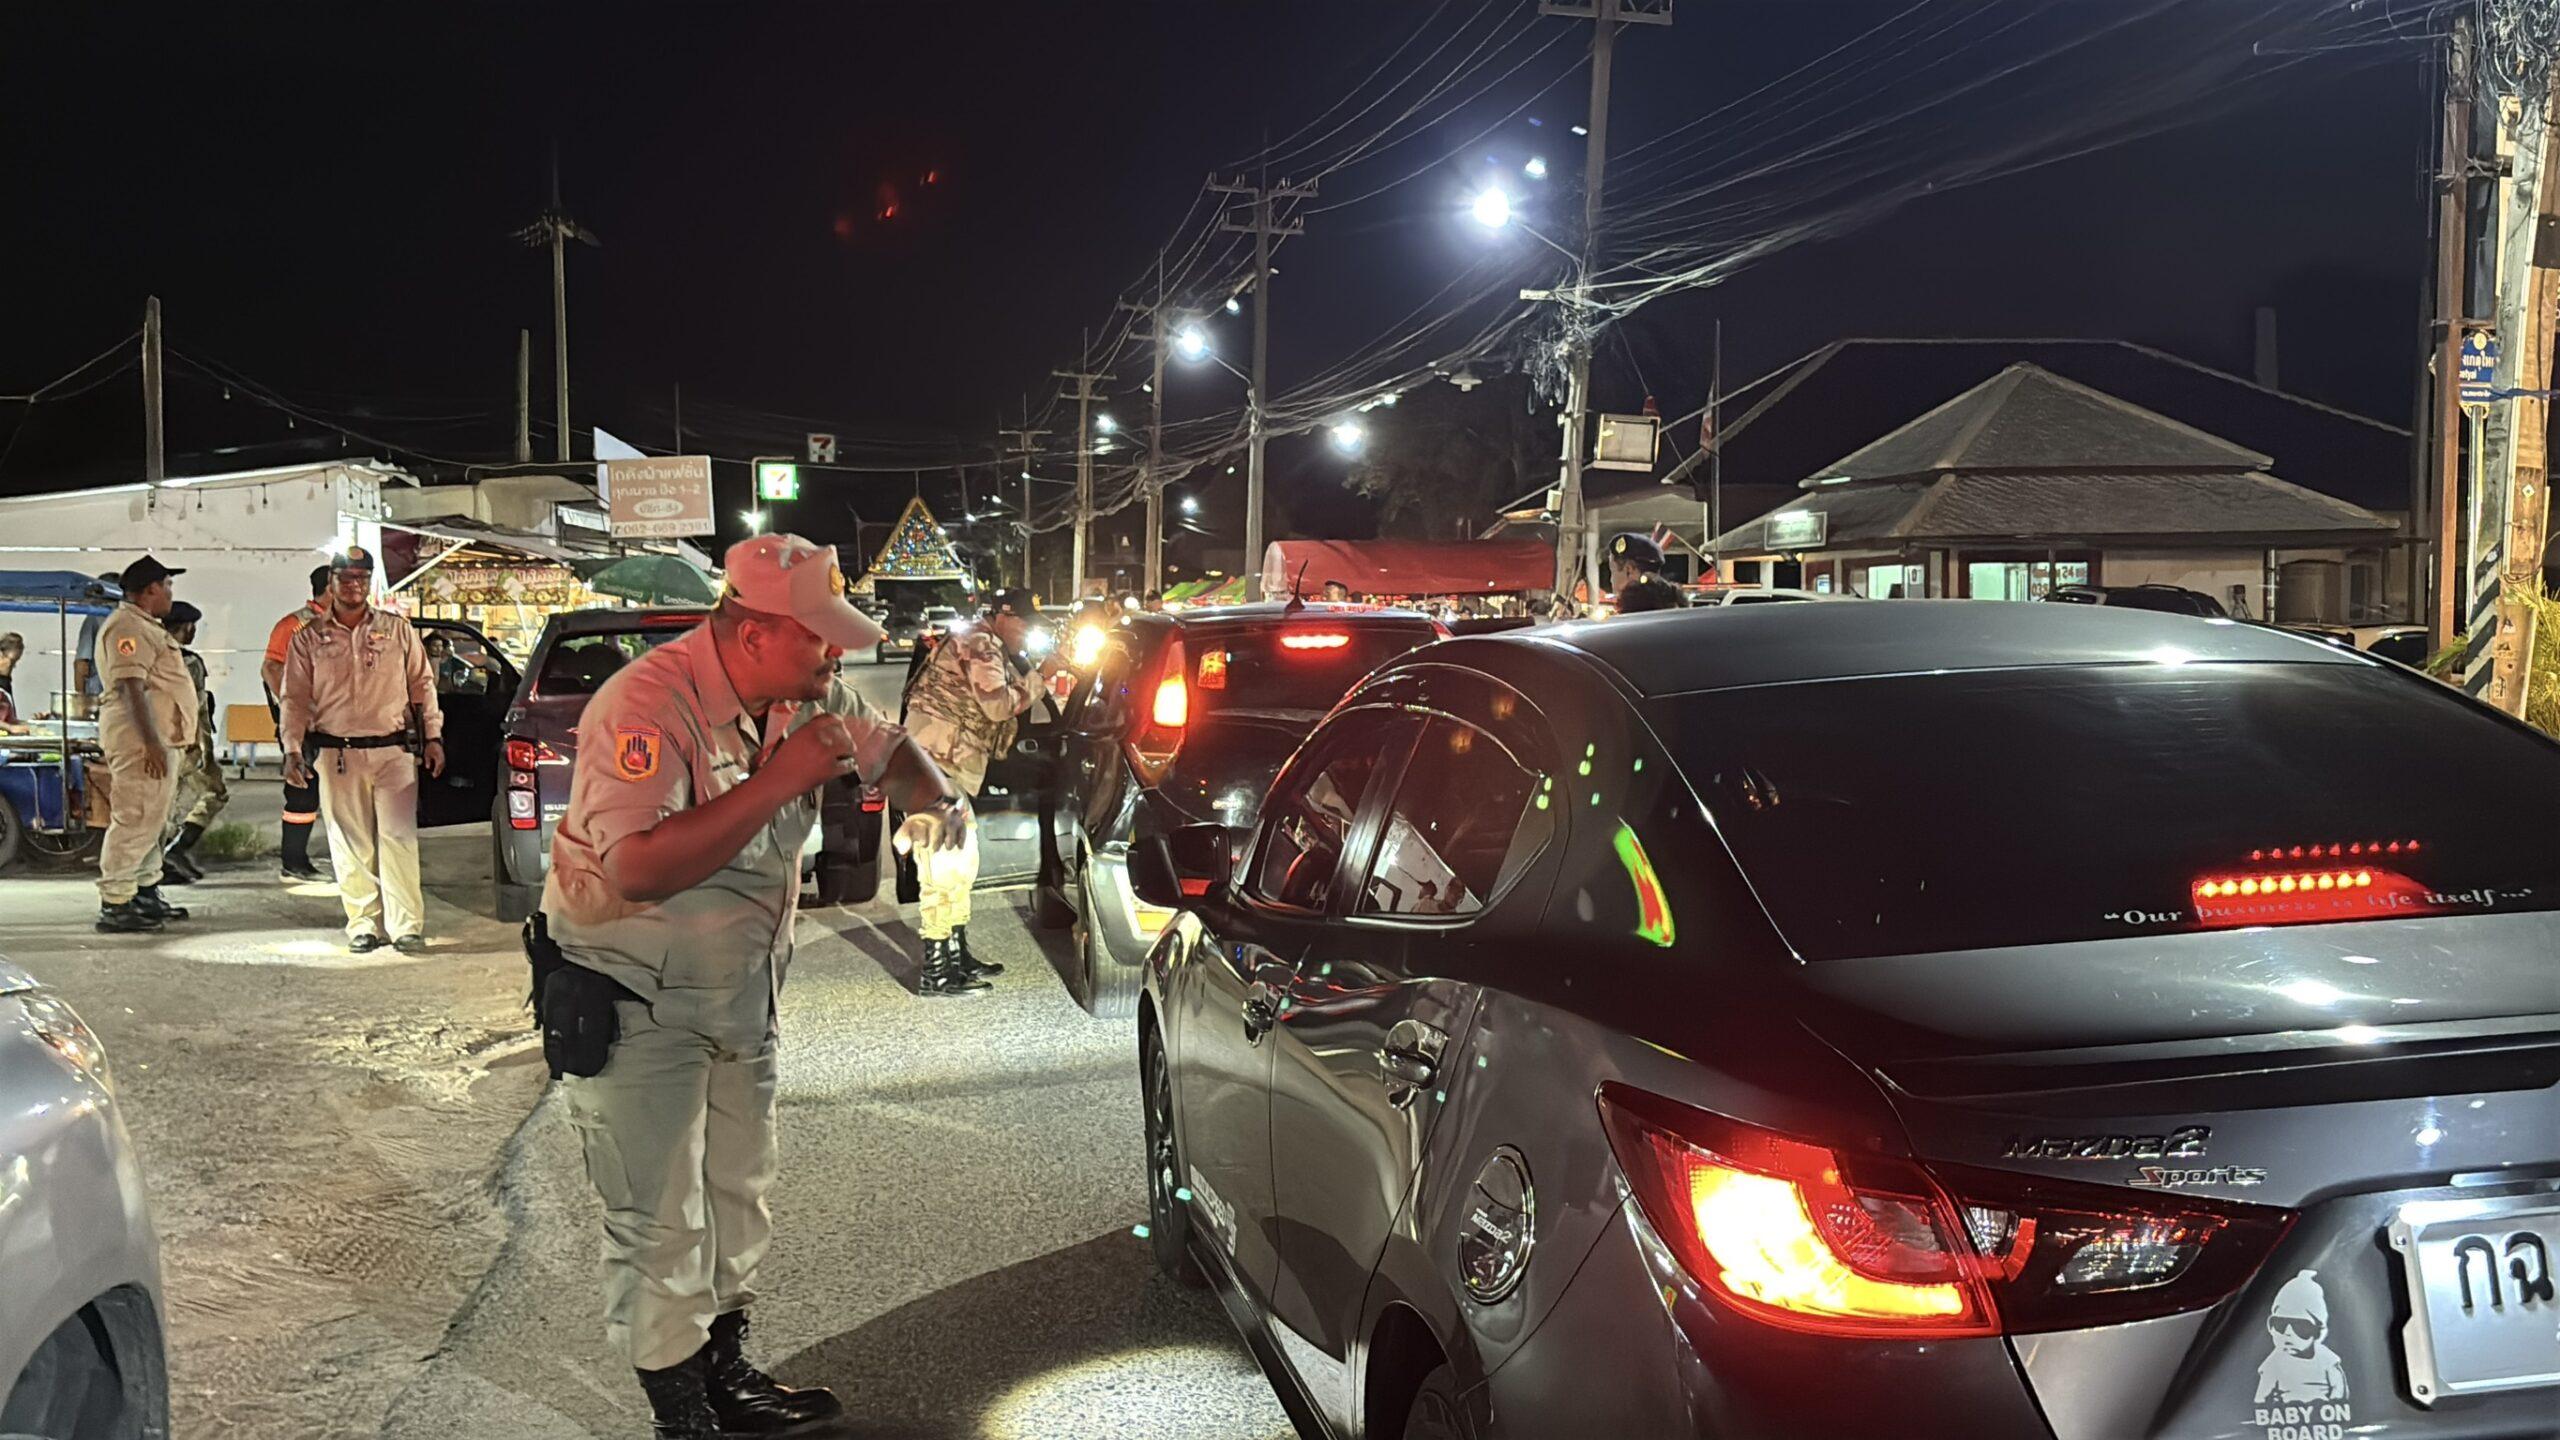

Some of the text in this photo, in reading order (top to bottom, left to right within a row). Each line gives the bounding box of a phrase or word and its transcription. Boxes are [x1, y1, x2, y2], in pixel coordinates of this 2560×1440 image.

[2367, 891, 2413, 908] life
[2126, 1165, 2268, 1188] Sports
[2254, 1403, 2352, 1426] BABY ON
[2267, 1424, 2343, 1440] BOARD
